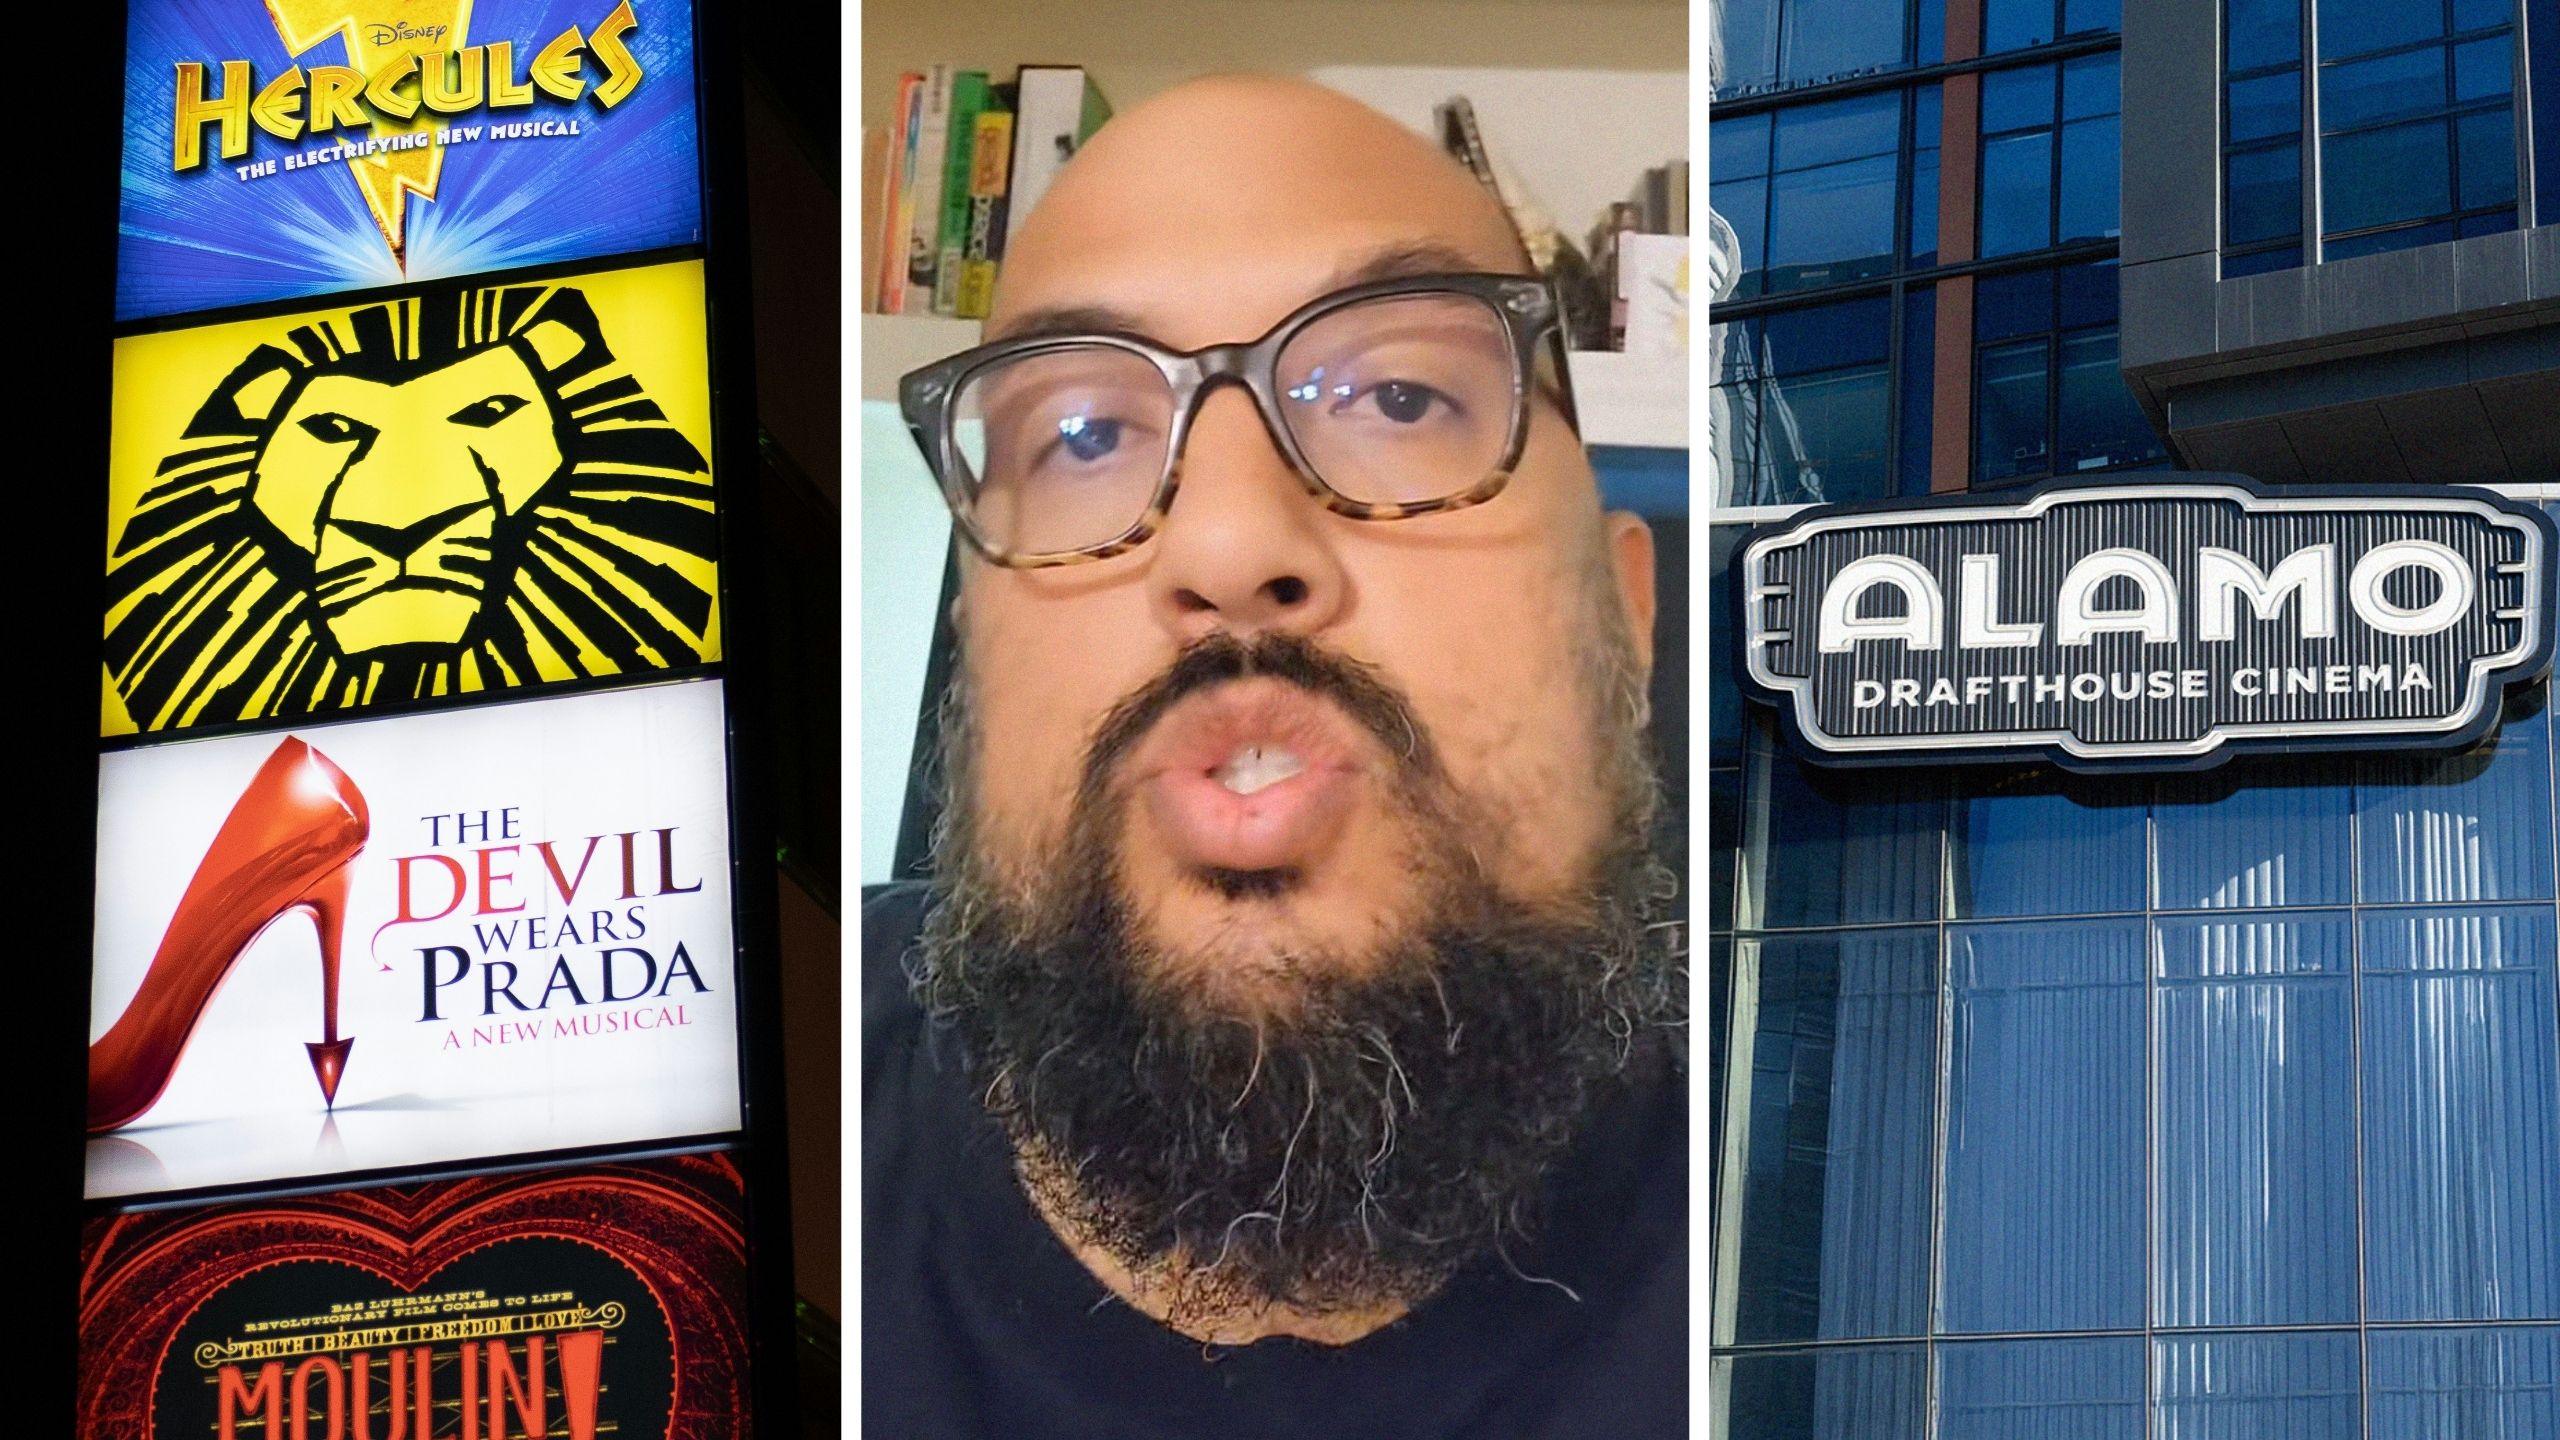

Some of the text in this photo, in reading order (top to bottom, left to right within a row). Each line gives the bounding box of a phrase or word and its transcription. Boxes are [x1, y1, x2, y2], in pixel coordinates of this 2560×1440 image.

[174, 0, 643, 171] HERCULES
[236, 120, 580, 181] THE ELECTRIFYING NEW MUSICAL
[1817, 539, 2474, 653] ALAMO
[1853, 662, 2434, 709] DRAFTHOUSE CINEMA
[420, 806, 521, 847] THE
[371, 826, 703, 935] DEVIL
[472, 905, 646, 955] WEARS
[413, 940, 714, 1023] PRADA
[443, 1005, 692, 1050] A NEW MUSICAL
[244, 1292, 573, 1332] REVOLUTIONARY FILM COMES TO LIFE
[369, 1290, 486, 1310] LUHRMANN'S
[238, 1309, 583, 1358] TRUTH BEAUTY FREEDOM LOVE
